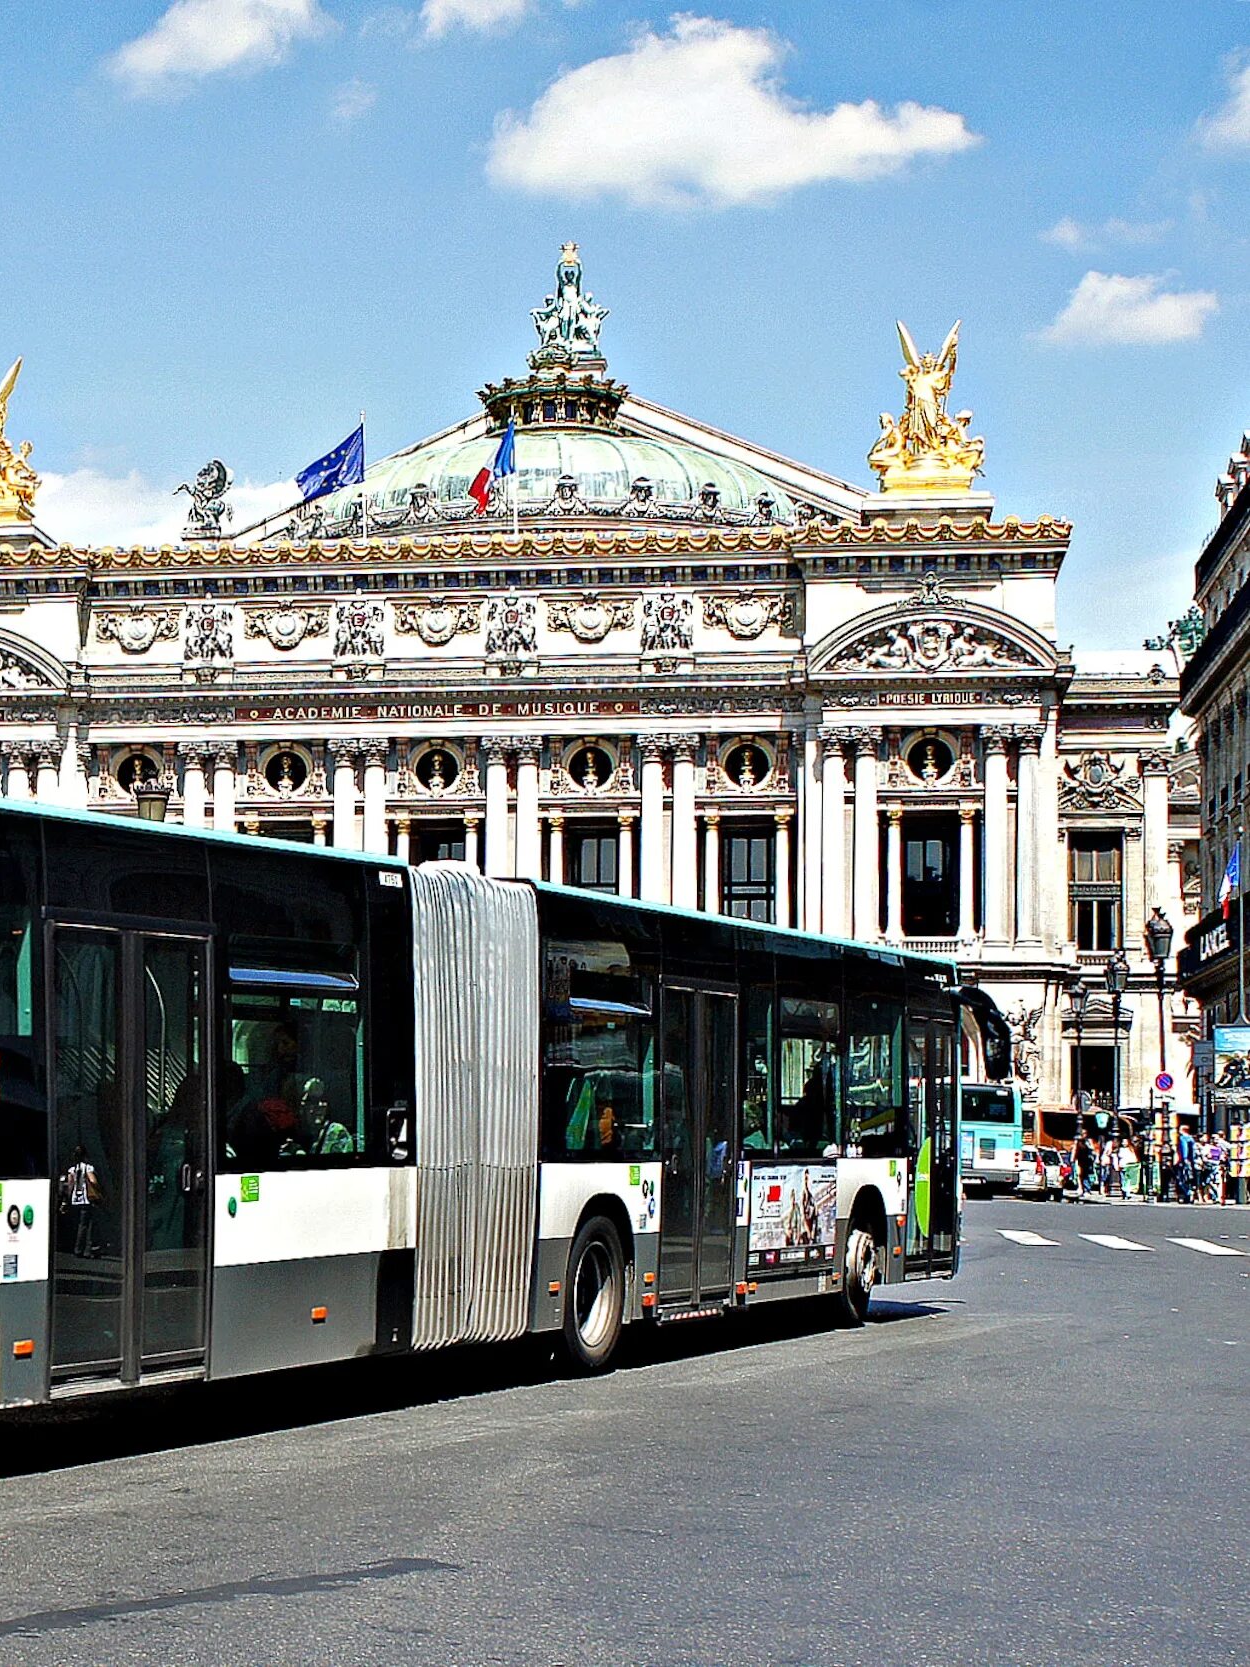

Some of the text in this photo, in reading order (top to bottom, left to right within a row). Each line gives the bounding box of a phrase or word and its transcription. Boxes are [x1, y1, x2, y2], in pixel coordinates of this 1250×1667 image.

[885, 692, 976, 705] POESIE LYRIQUE
[272, 701, 600, 720] ACADEMIE NATIONALE DE MUSIQUE
